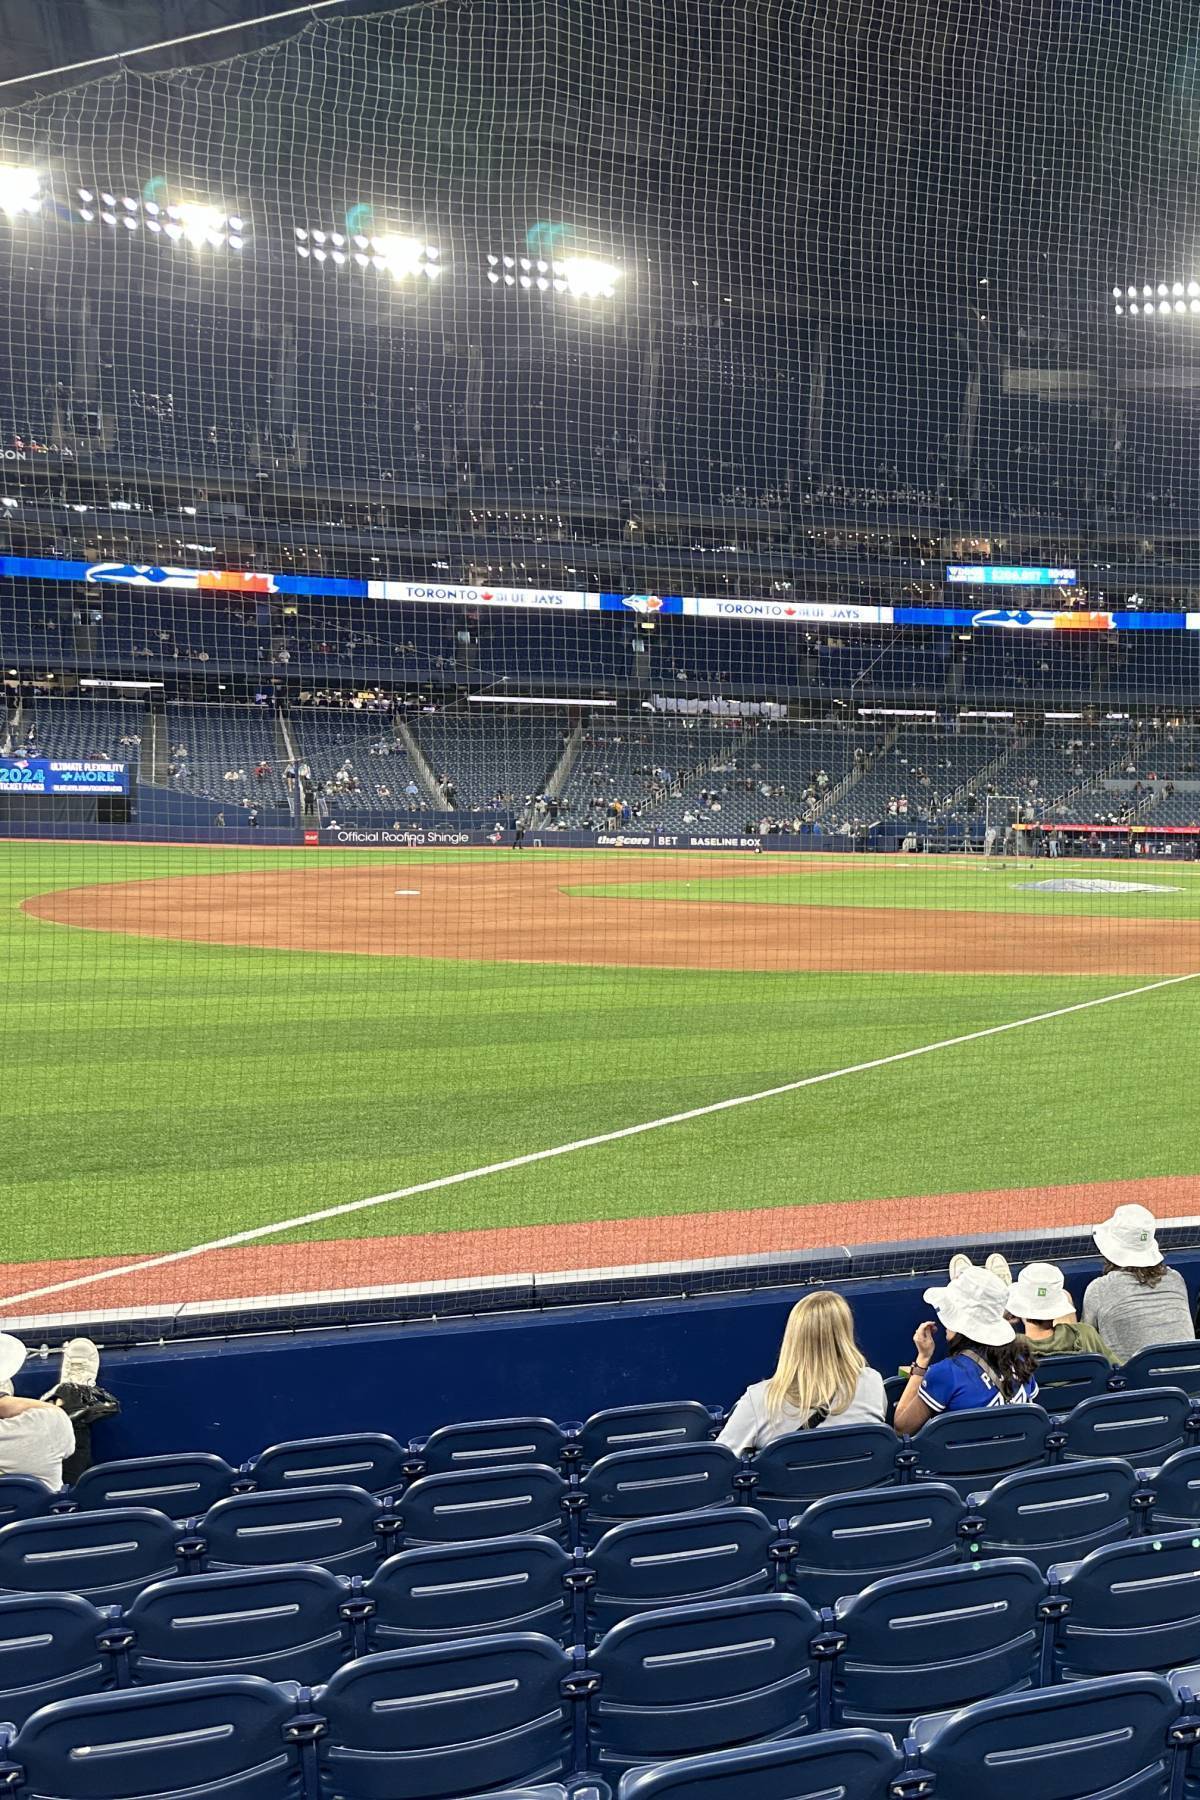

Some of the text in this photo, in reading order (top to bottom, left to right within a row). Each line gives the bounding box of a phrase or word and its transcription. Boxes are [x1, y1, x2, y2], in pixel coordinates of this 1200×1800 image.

[405, 587, 478, 600] TORONTO
[531, 594, 563, 605] JAYS
[716, 603, 782, 616] TORONTO
[831, 608, 860, 619] JAYS
[50, 762, 125, 772] ULTIMATE FLEXIBILITY
[0, 768, 45, 783] 2024
[23, 783, 45, 791] PACKS
[337, 831, 469, 845] Official Roofing Shingle
[597, 835, 678, 846] theScore BET
[690, 837, 761, 847] BASELINE BOX
